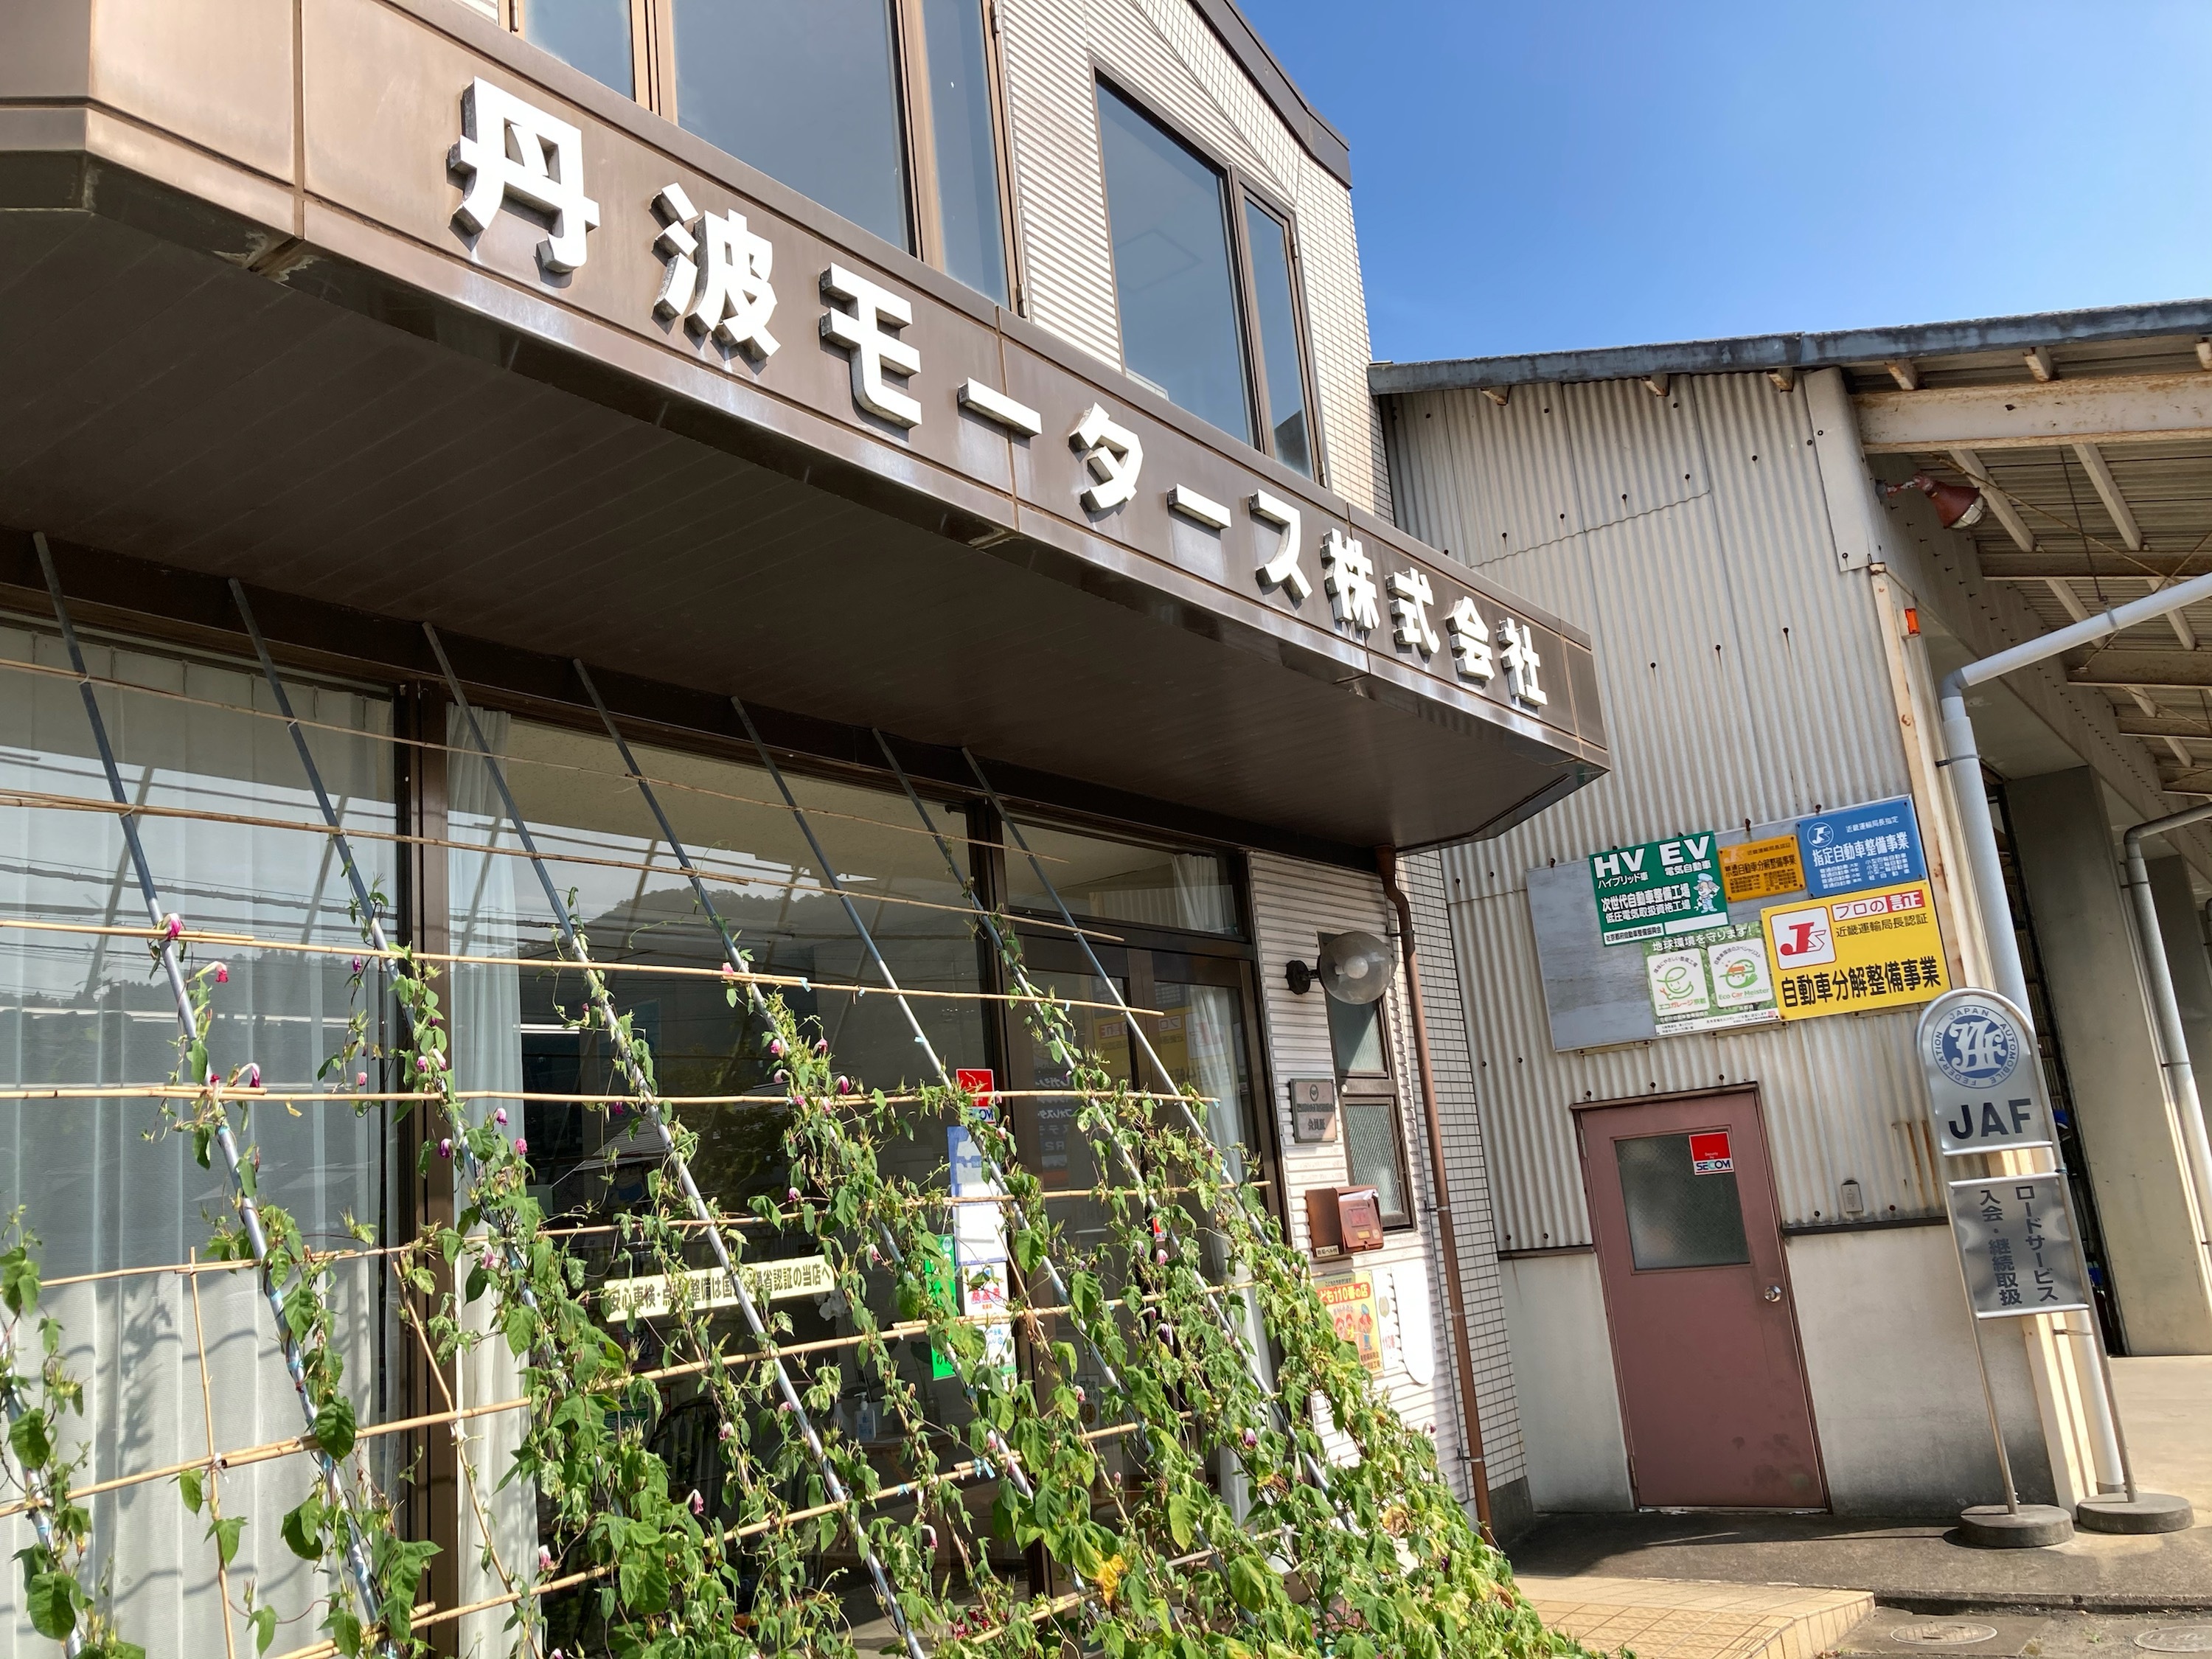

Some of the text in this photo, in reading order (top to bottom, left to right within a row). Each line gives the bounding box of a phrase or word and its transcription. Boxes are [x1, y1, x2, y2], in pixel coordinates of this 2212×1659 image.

[448, 77, 1548, 706] 丹波モータース株式会社
[1593, 835, 1710, 878] HV EV
[1812, 832, 1910, 867] 指定自動車整備事業
[1598, 872, 1649, 889] ハイブリッド車
[1664, 860, 1711, 876] 電気自動車
[1601, 883, 1691, 912] 次世代自動車整備工場
[1605, 900, 1691, 923] 低圧電気取扱資格工場
[1652, 925, 1753, 951] 地球環境を守ります!
[1835, 914, 1928, 938] 近畿運輸局長認証
[1744, 988, 1770, 997] Meister
[1781, 956, 1941, 1008] 自動車分解整備事業
[1934, 1007, 2017, 1086] JAPAN AUTOMOBILE FEDERATION
[1949, 1098, 2032, 1140] JAF
[1696, 1160, 1731, 1171] SECOM
[1979, 1189, 2023, 1307] 入会・継続取扱
[2015, 1185, 2059, 1303] ロードサービス
